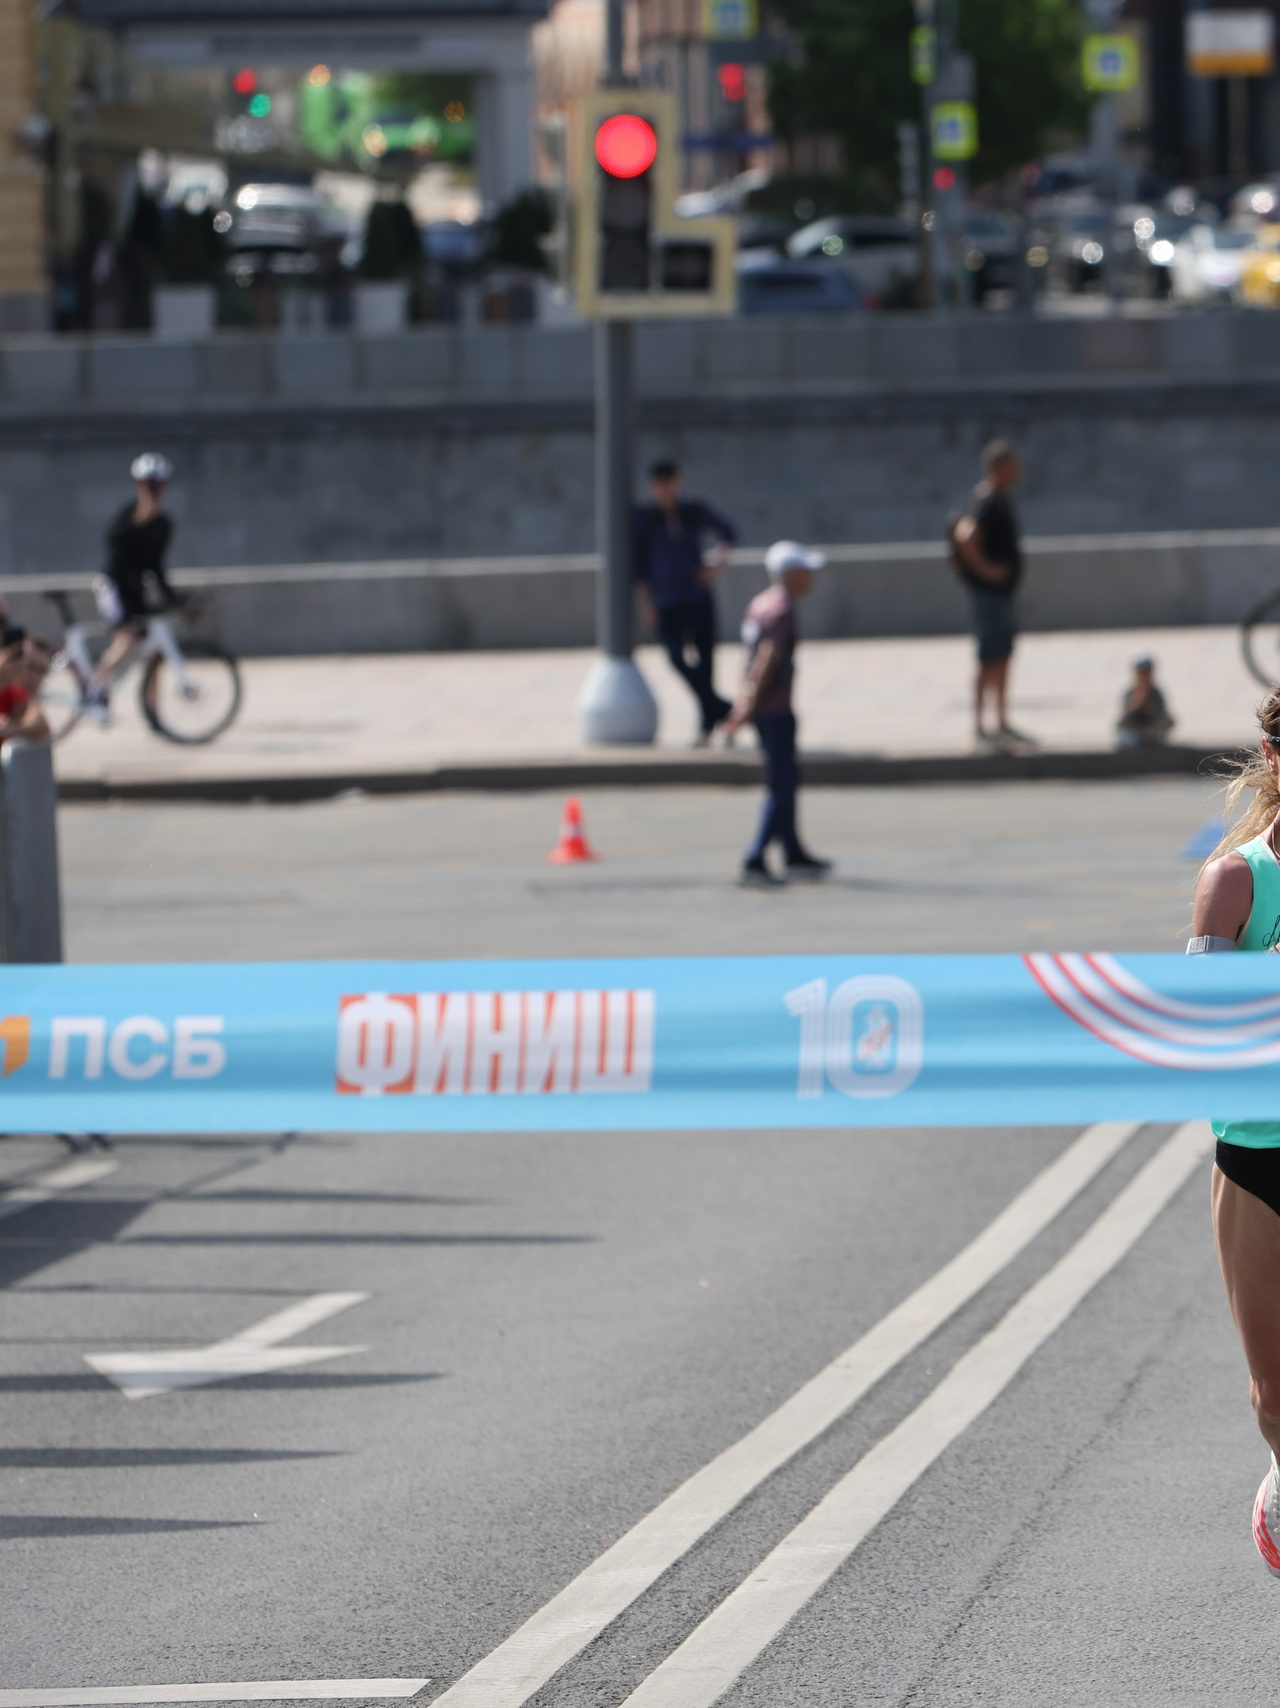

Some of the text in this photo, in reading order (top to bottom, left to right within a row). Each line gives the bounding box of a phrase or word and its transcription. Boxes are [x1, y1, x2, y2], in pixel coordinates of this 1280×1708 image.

[48, 1015, 226, 1080] ПСБ
[336, 988, 655, 1096] ФИНИШ
[782, 974, 924, 1100] 10
